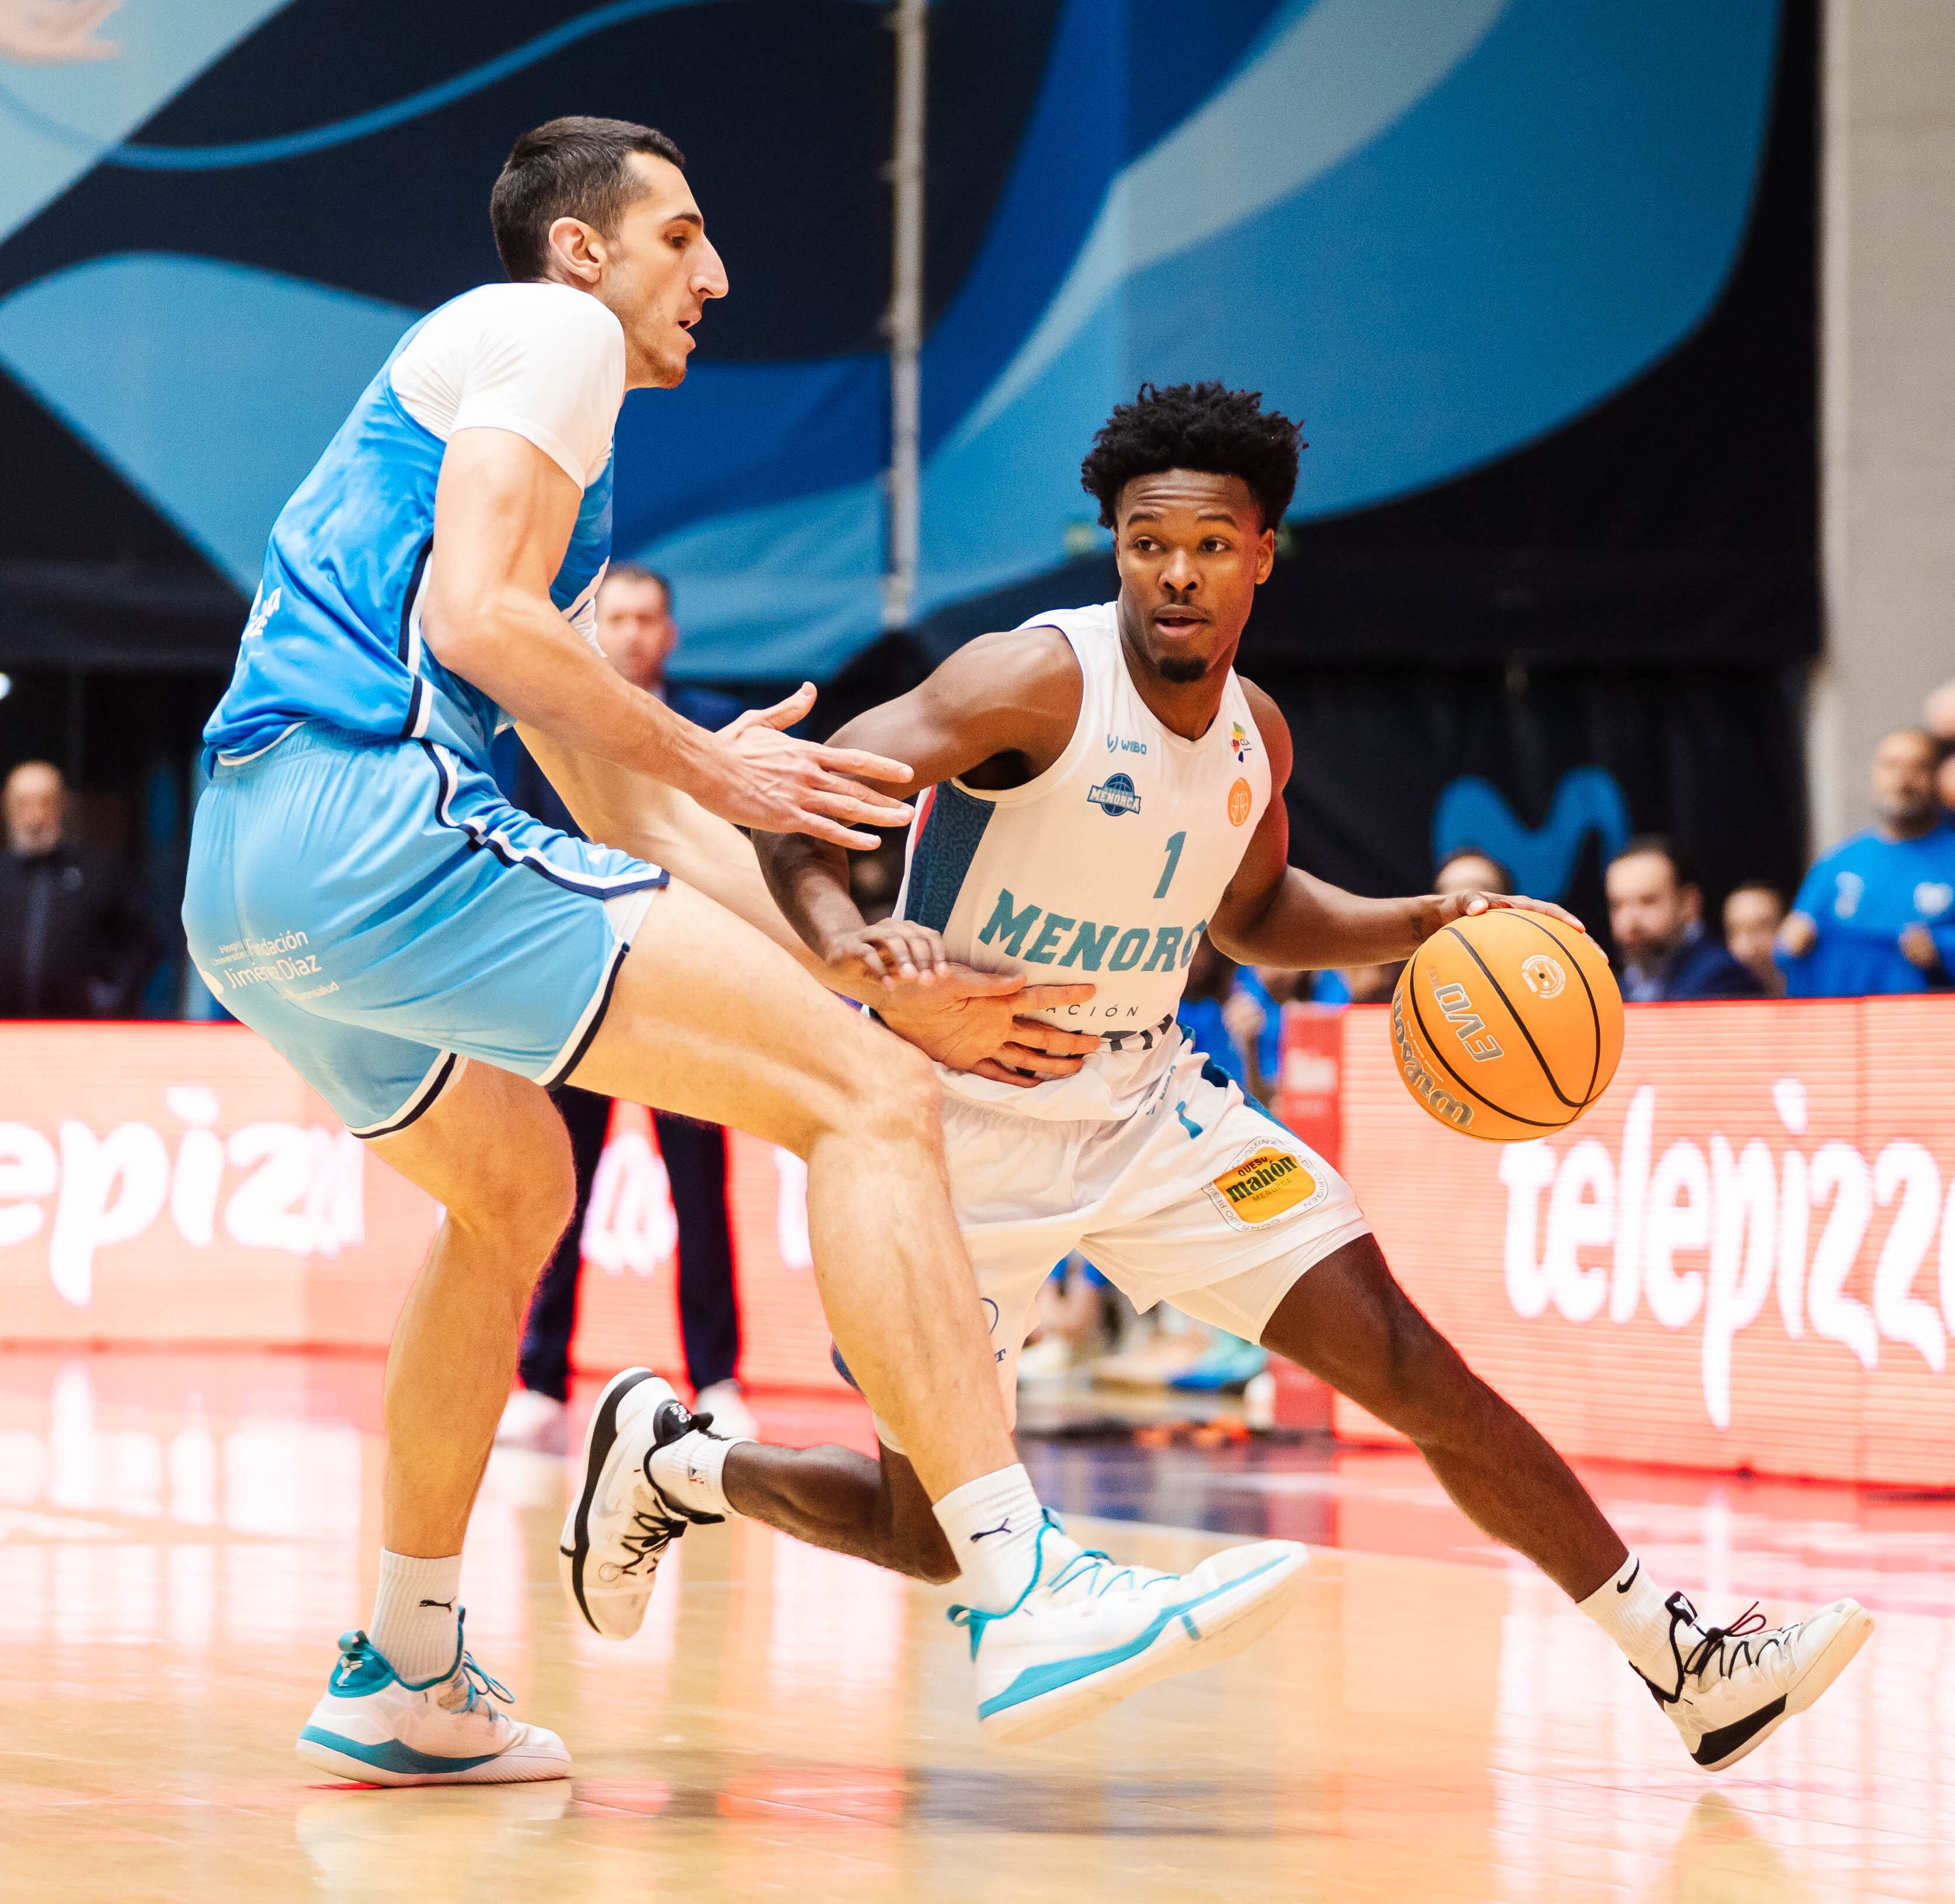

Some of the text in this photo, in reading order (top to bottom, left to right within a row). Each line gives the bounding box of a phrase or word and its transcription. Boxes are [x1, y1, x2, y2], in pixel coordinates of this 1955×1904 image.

[1121, 739, 1147, 755] WIBO
[1090, 788, 1140, 812] MENORCA
[1153, 831, 1187, 899] 1
[276, 955, 323, 981] Díaz
[1434, 983, 1505, 1062] EVO
[1226, 1156, 1297, 1203] mahón
[1498, 1078, 1955, 1430] telepizz
